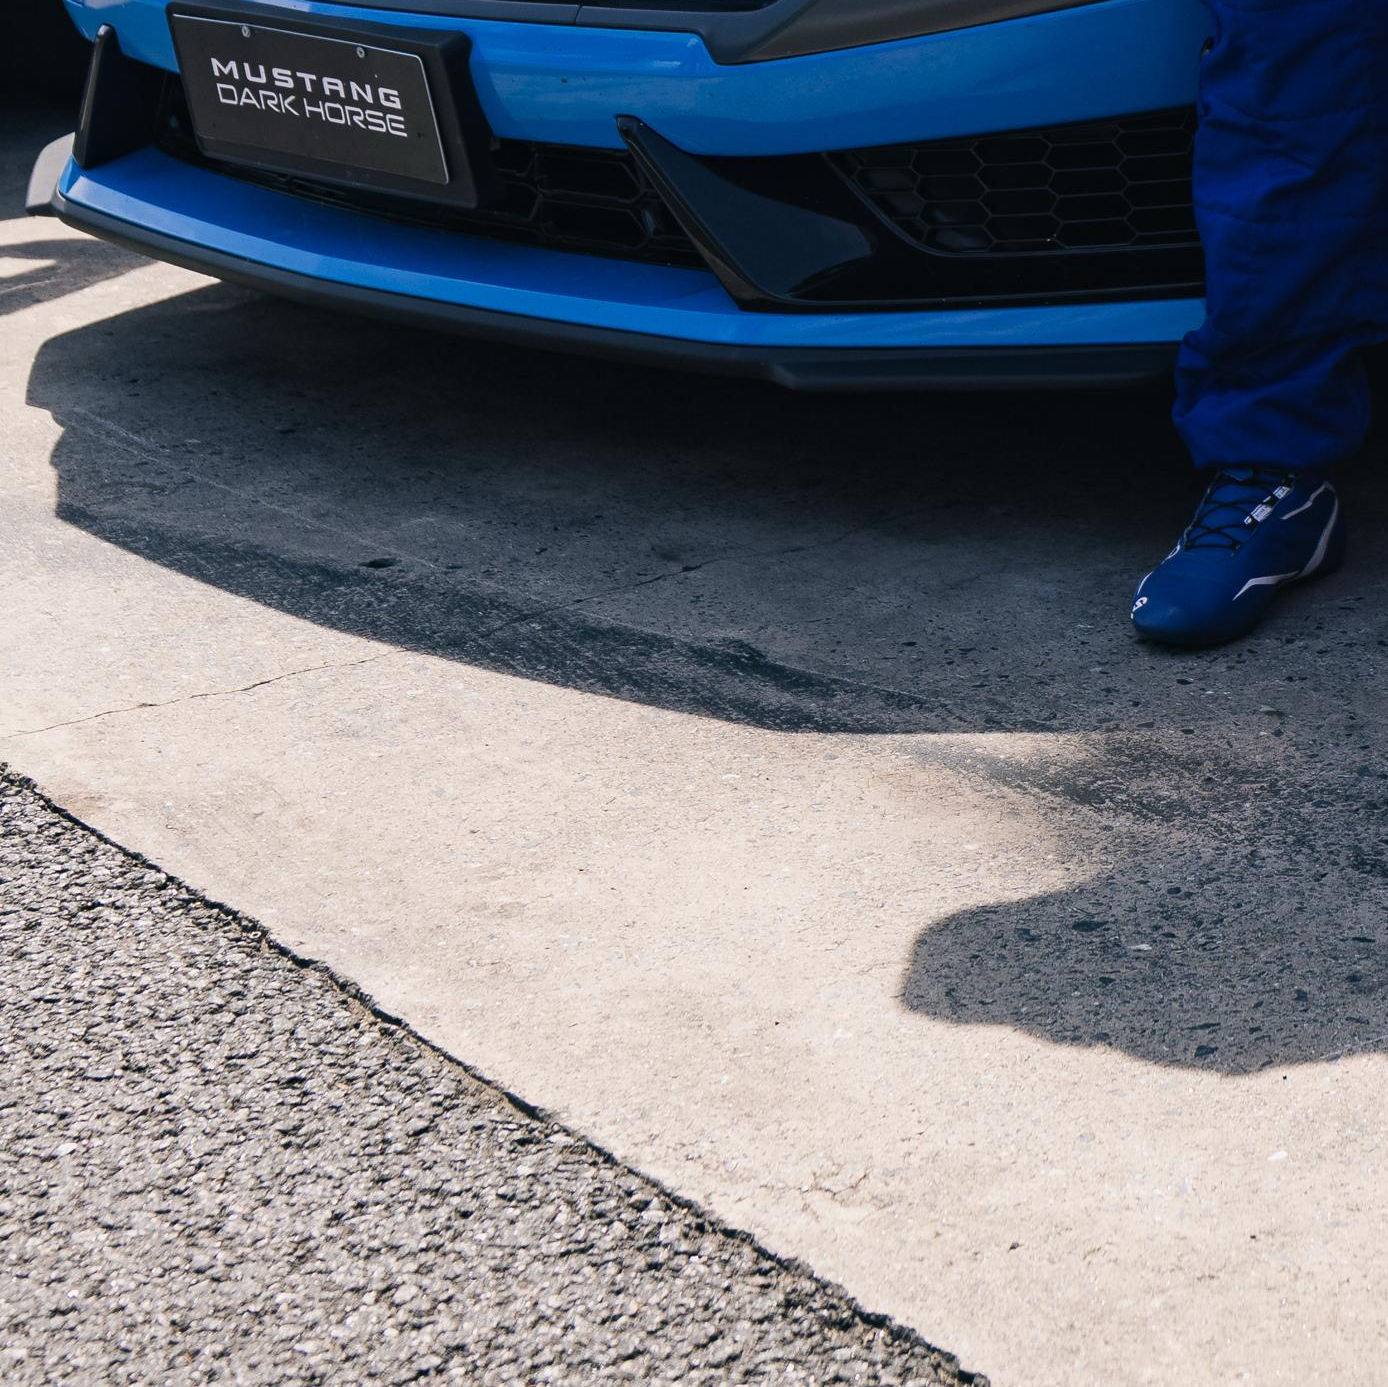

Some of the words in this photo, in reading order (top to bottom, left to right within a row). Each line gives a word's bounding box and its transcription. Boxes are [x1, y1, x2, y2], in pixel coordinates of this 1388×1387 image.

[210, 57, 401, 109] MUSTANG
[216, 82, 300, 116] DARK
[303, 97, 408, 138] HORSE
